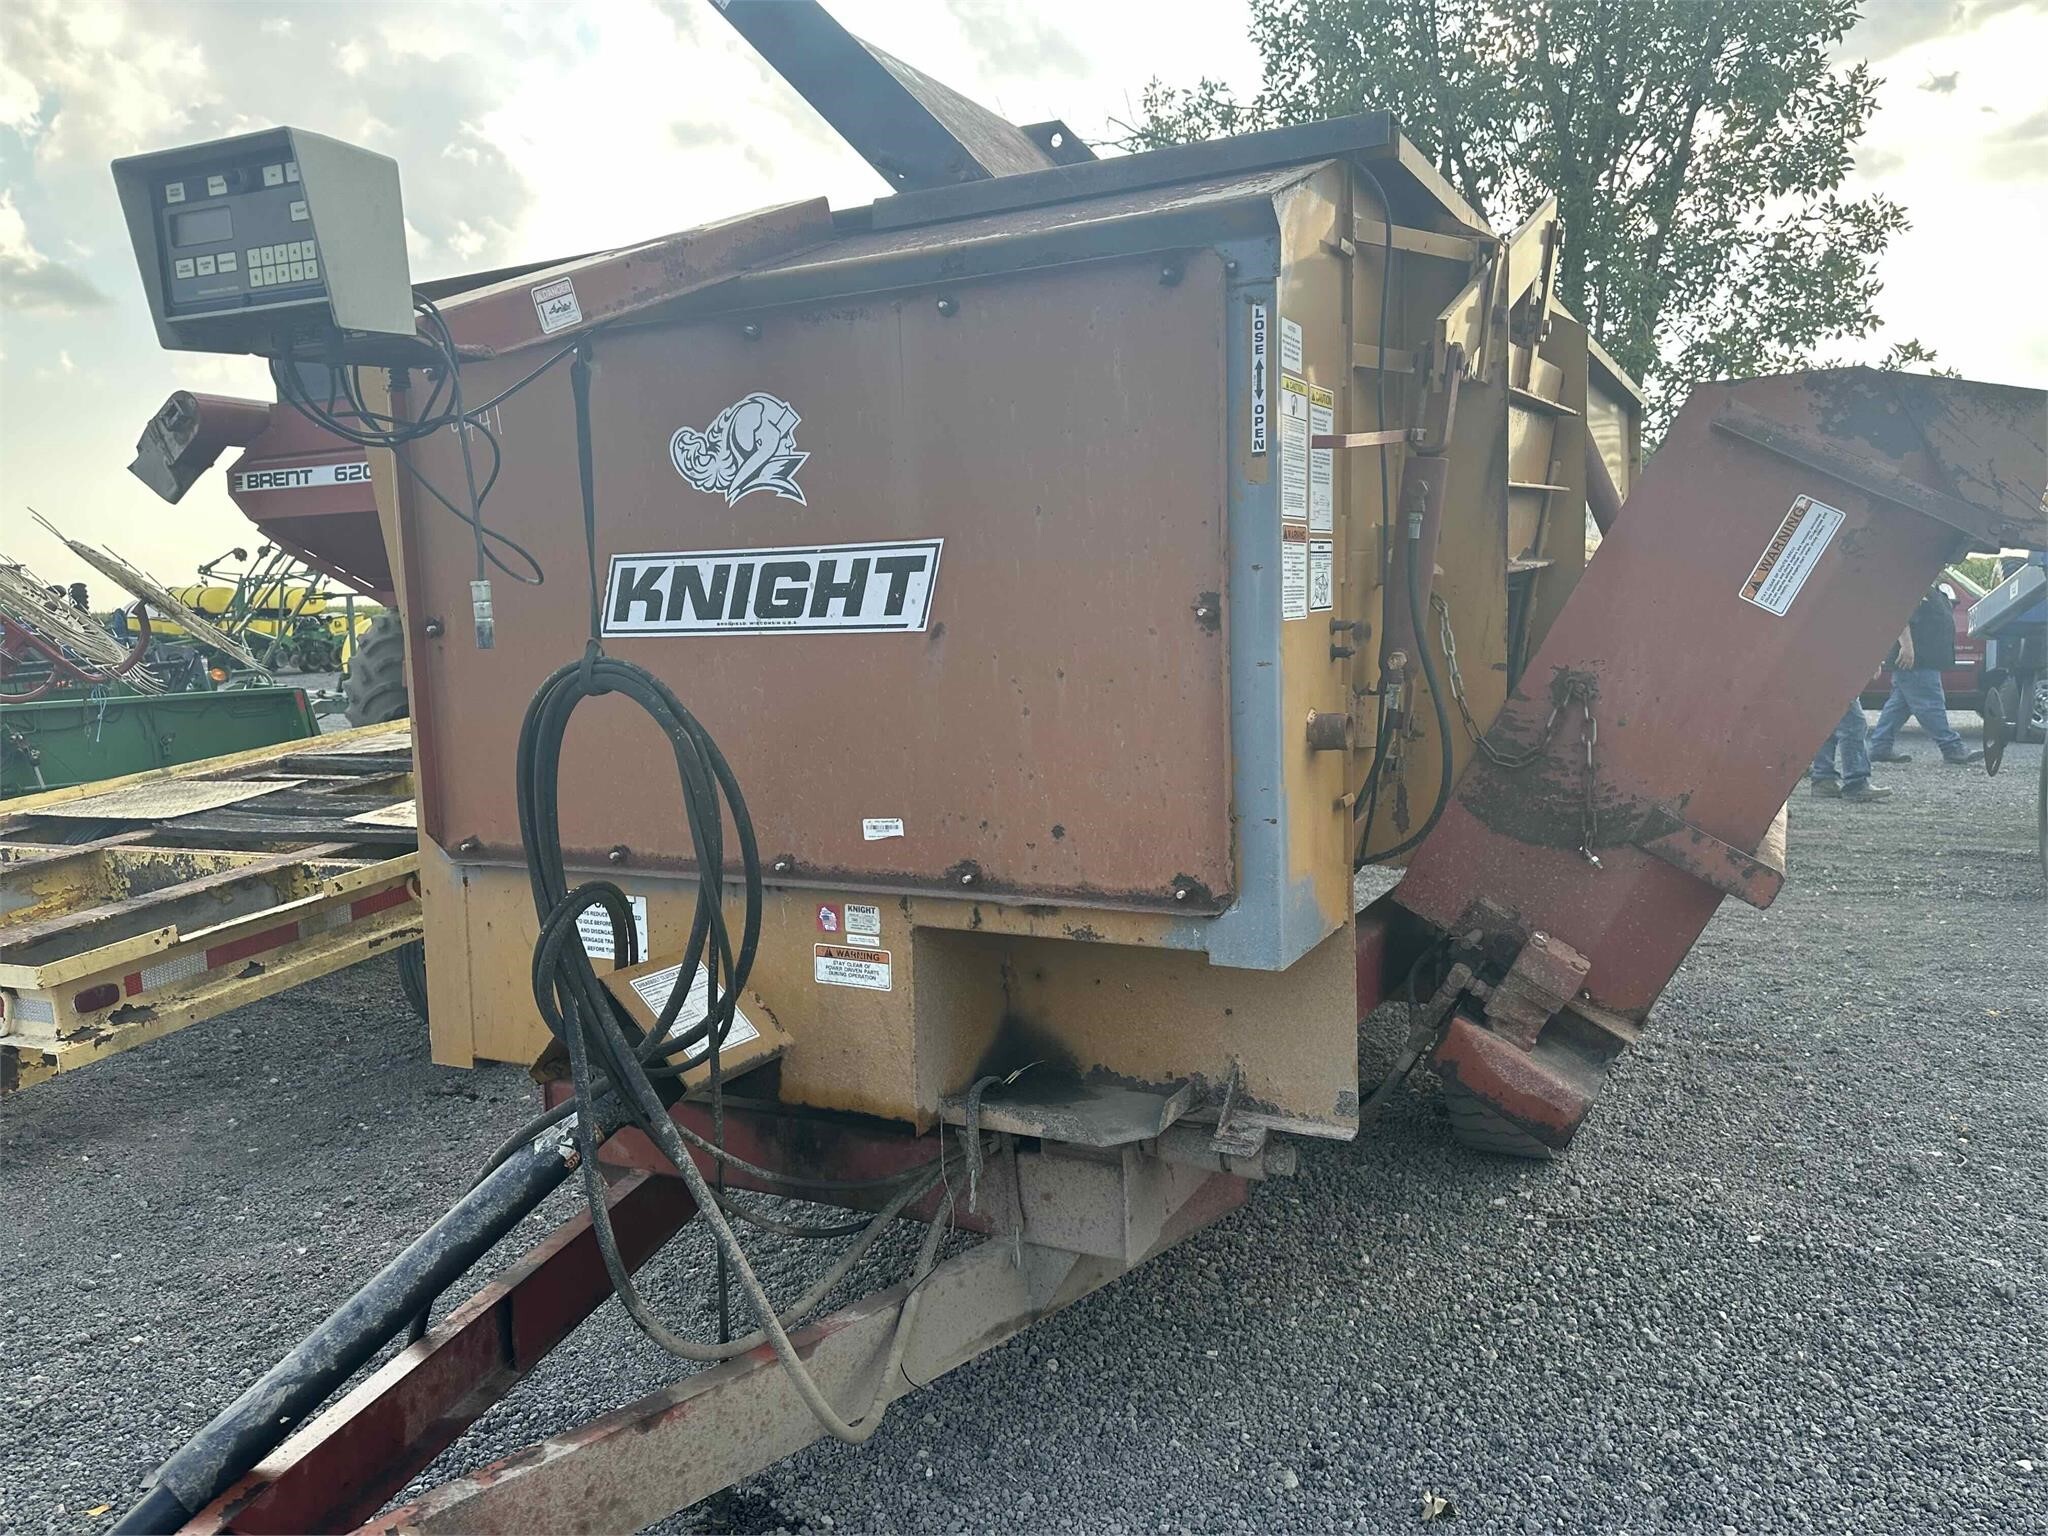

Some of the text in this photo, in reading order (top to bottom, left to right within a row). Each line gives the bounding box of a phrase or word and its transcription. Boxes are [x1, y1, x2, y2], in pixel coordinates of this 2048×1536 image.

[1254, 303, 1264, 354] LOSE
[1253, 404, 1265, 450] OPEN
[247, 469, 313, 489] BRENT
[1760, 506, 1804, 572] WARNING
[613, 555, 927, 622] KNIGHT
[847, 905, 876, 914] KNIGHT
[837, 949, 880, 961] WARNING
[848, 973, 877, 981] OPERATION
